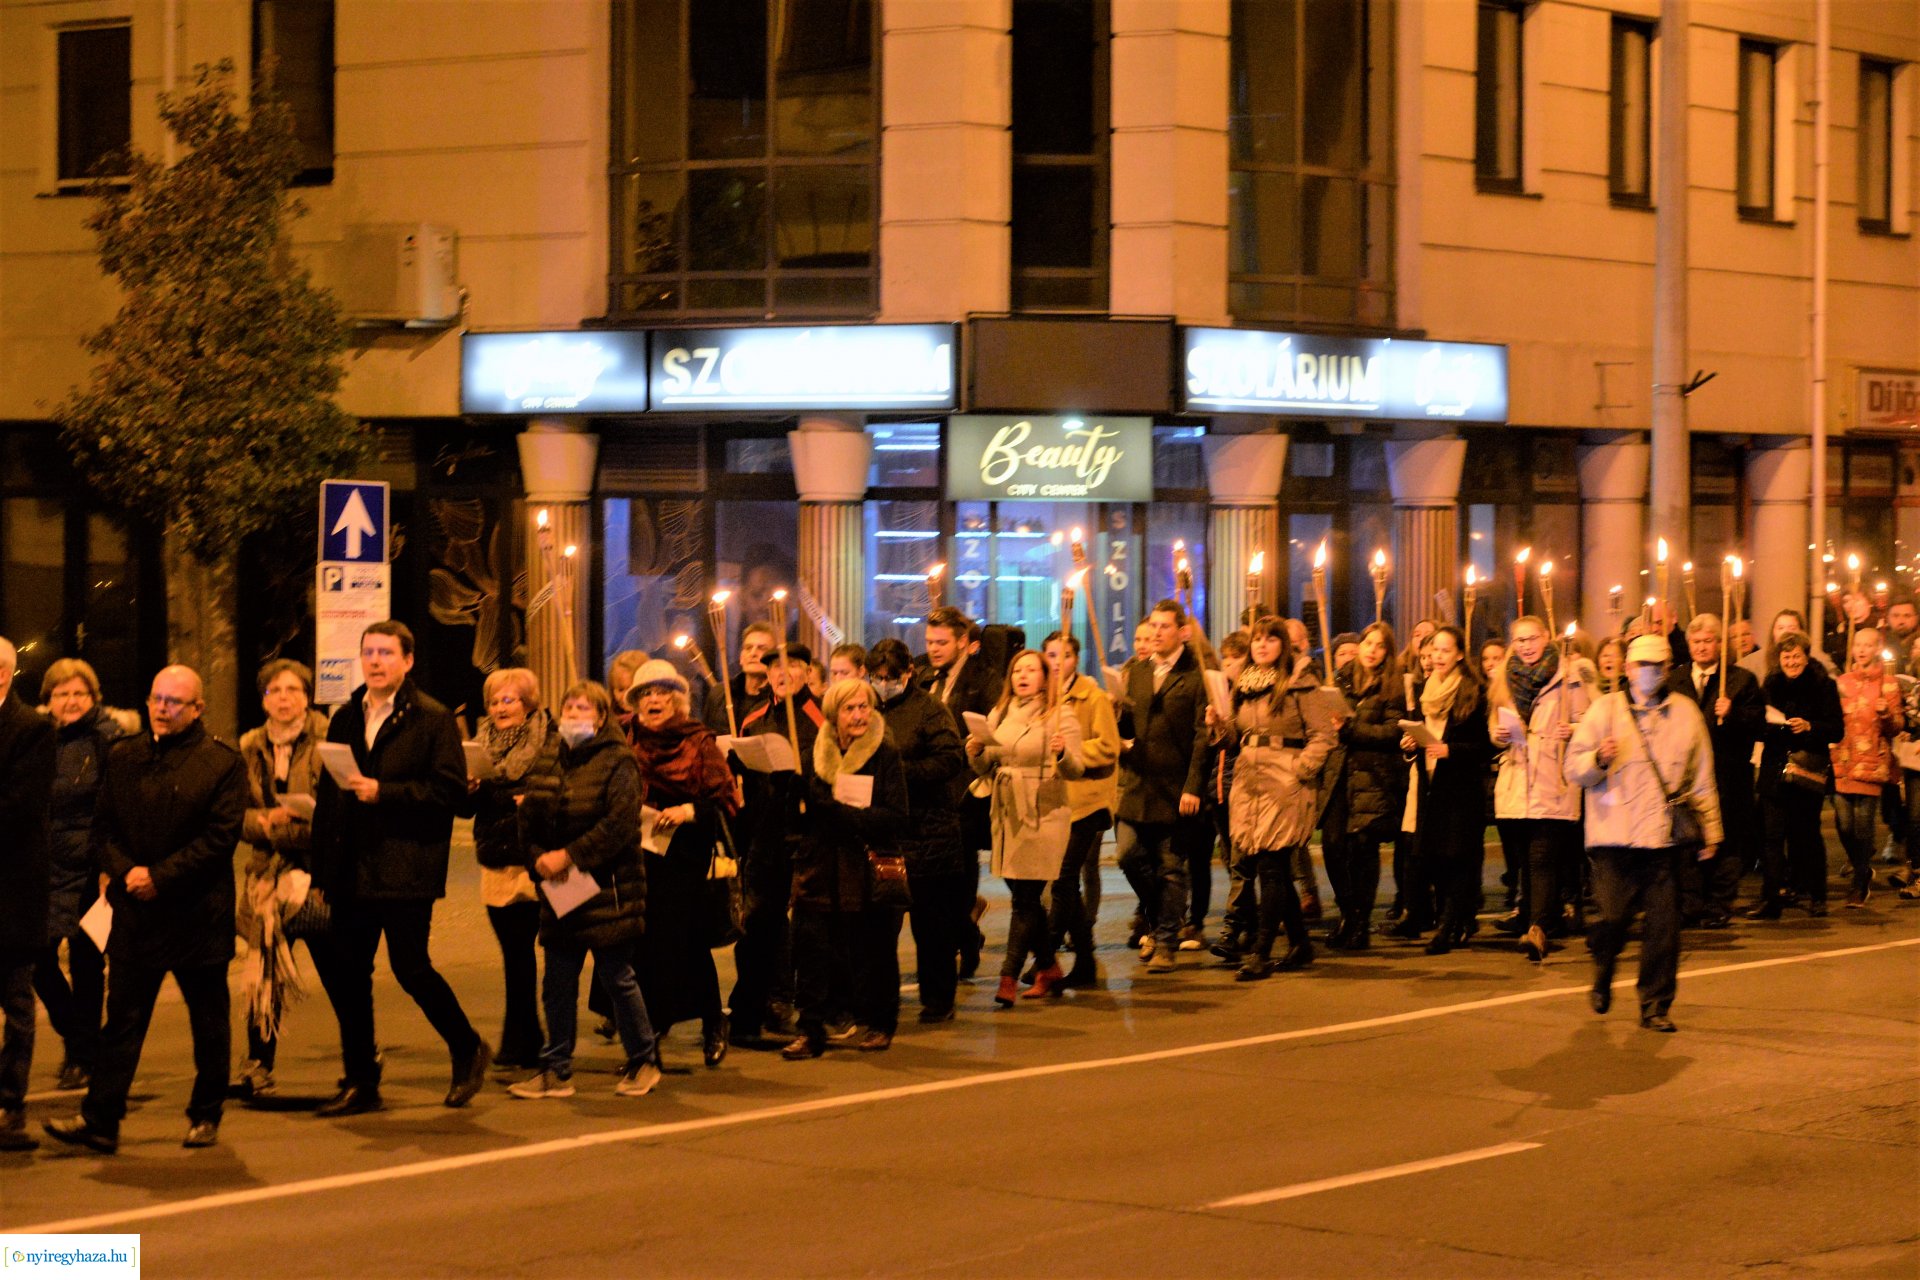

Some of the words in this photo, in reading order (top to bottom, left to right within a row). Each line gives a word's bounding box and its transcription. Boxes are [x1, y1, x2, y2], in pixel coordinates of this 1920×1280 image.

[980, 421, 1125, 489] Beauty
[1006, 484, 1039, 496] CITY
[1039, 484, 1088, 497] CENTER
